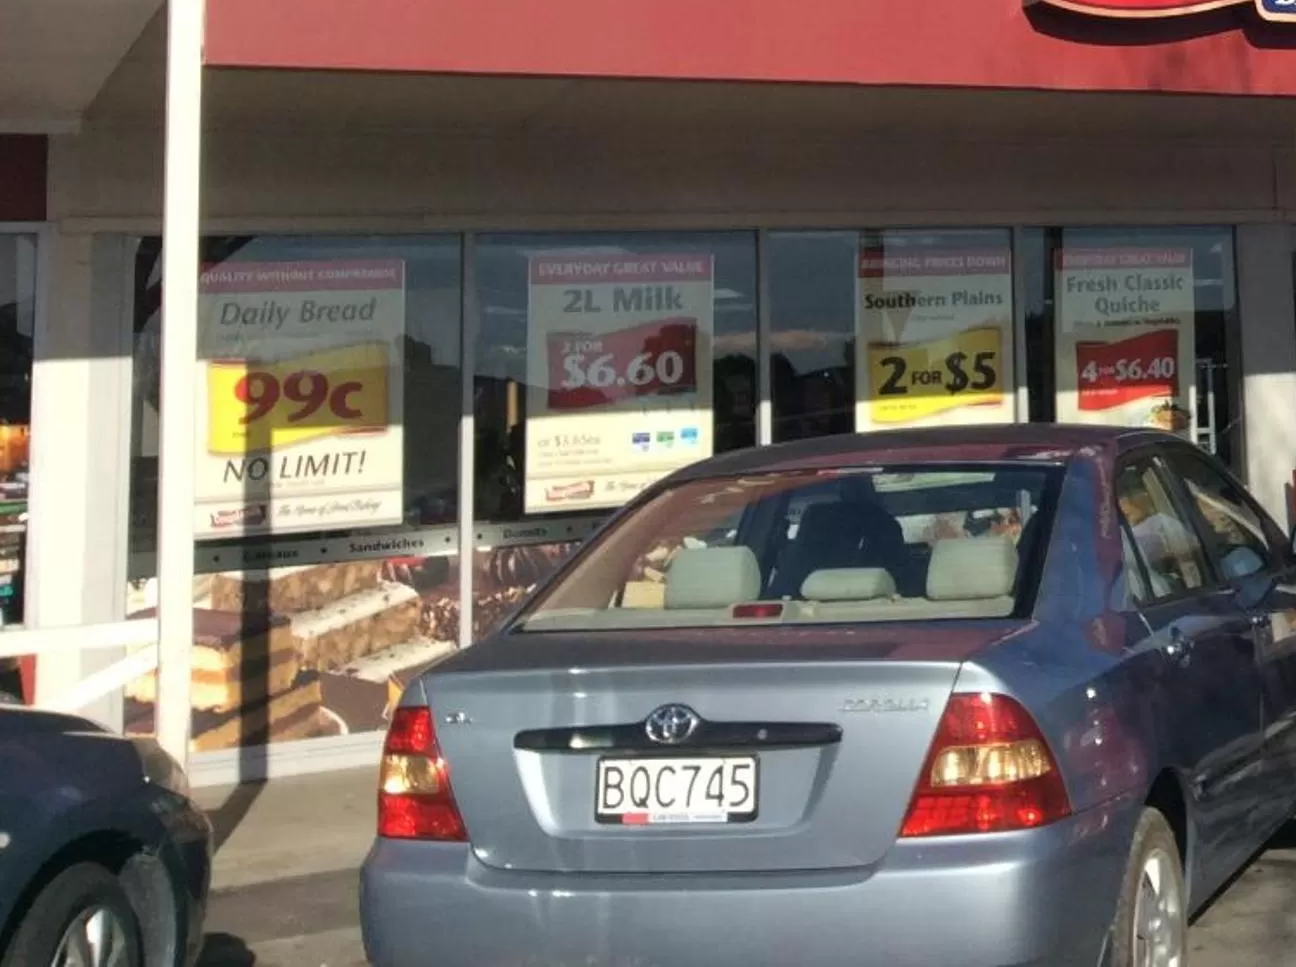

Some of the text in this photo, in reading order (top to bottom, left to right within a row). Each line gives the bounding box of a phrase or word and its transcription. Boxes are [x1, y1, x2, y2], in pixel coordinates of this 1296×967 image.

[612, 260, 658, 275] GREAT
[659, 259, 704, 274] VALUE
[1067, 272, 1184, 293] Fresh Classic
[220, 296, 377, 330] Daily Bread
[563, 286, 684, 313] 2L Milk
[864, 289, 1003, 310] Southern Plains
[1094, 294, 1161, 316] Quiche
[561, 350, 684, 390] $6.60
[878, 351, 997, 396] 2 FOR $5
[1081, 360, 1098, 383] 4
[1115, 356, 1175, 383] $6.40
[234, 369, 364, 424] 99c
[223, 450, 367, 483] NO LIMIT!
[350, 537, 425, 553] Sandwiches
[602, 764, 750, 809] BQC745
